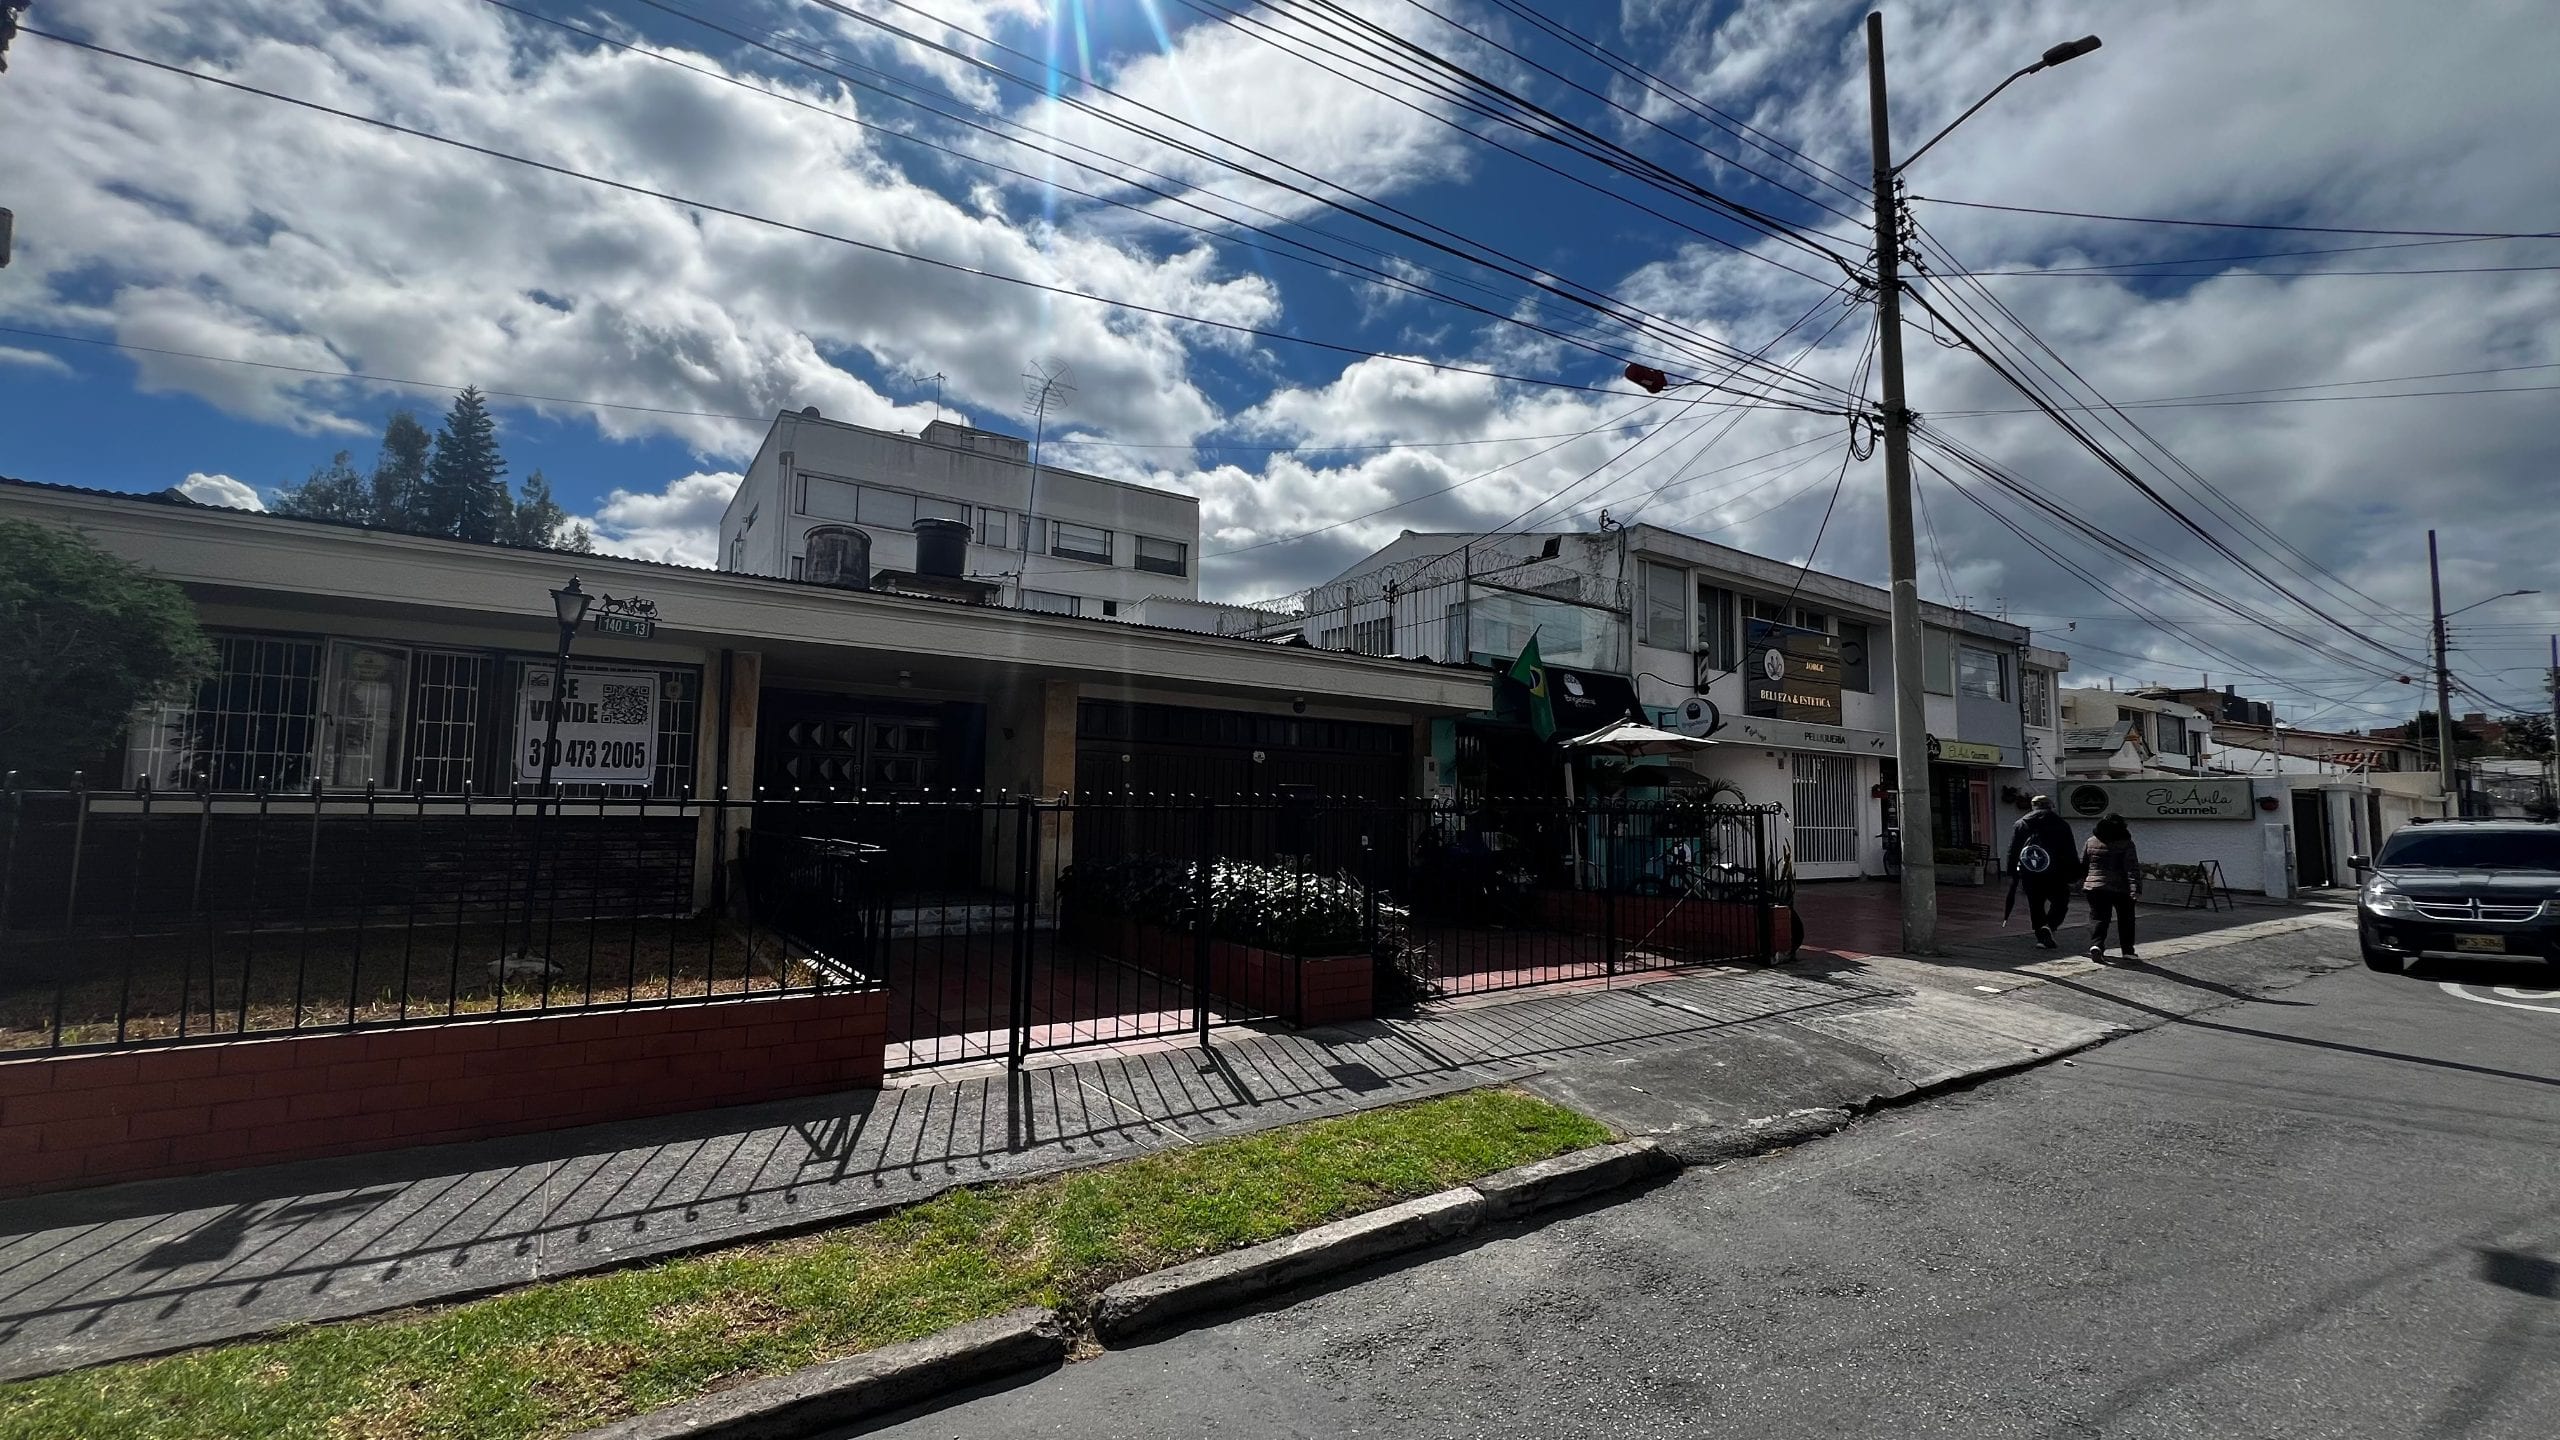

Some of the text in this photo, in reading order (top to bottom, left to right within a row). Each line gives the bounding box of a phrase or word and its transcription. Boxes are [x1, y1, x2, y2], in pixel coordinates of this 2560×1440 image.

[604, 618, 622, 632] 140
[634, 622, 646, 635] 13
[1806, 661, 1824, 673] JORGE
[1761, 690, 1791, 704] BELLEZA
[1793, 694, 1798, 704] &
[566, 740, 597, 767] 473
[601, 741, 645, 768] 2005
[2146, 788, 2174, 806] El
[2157, 806, 2217, 815] Gourmet
